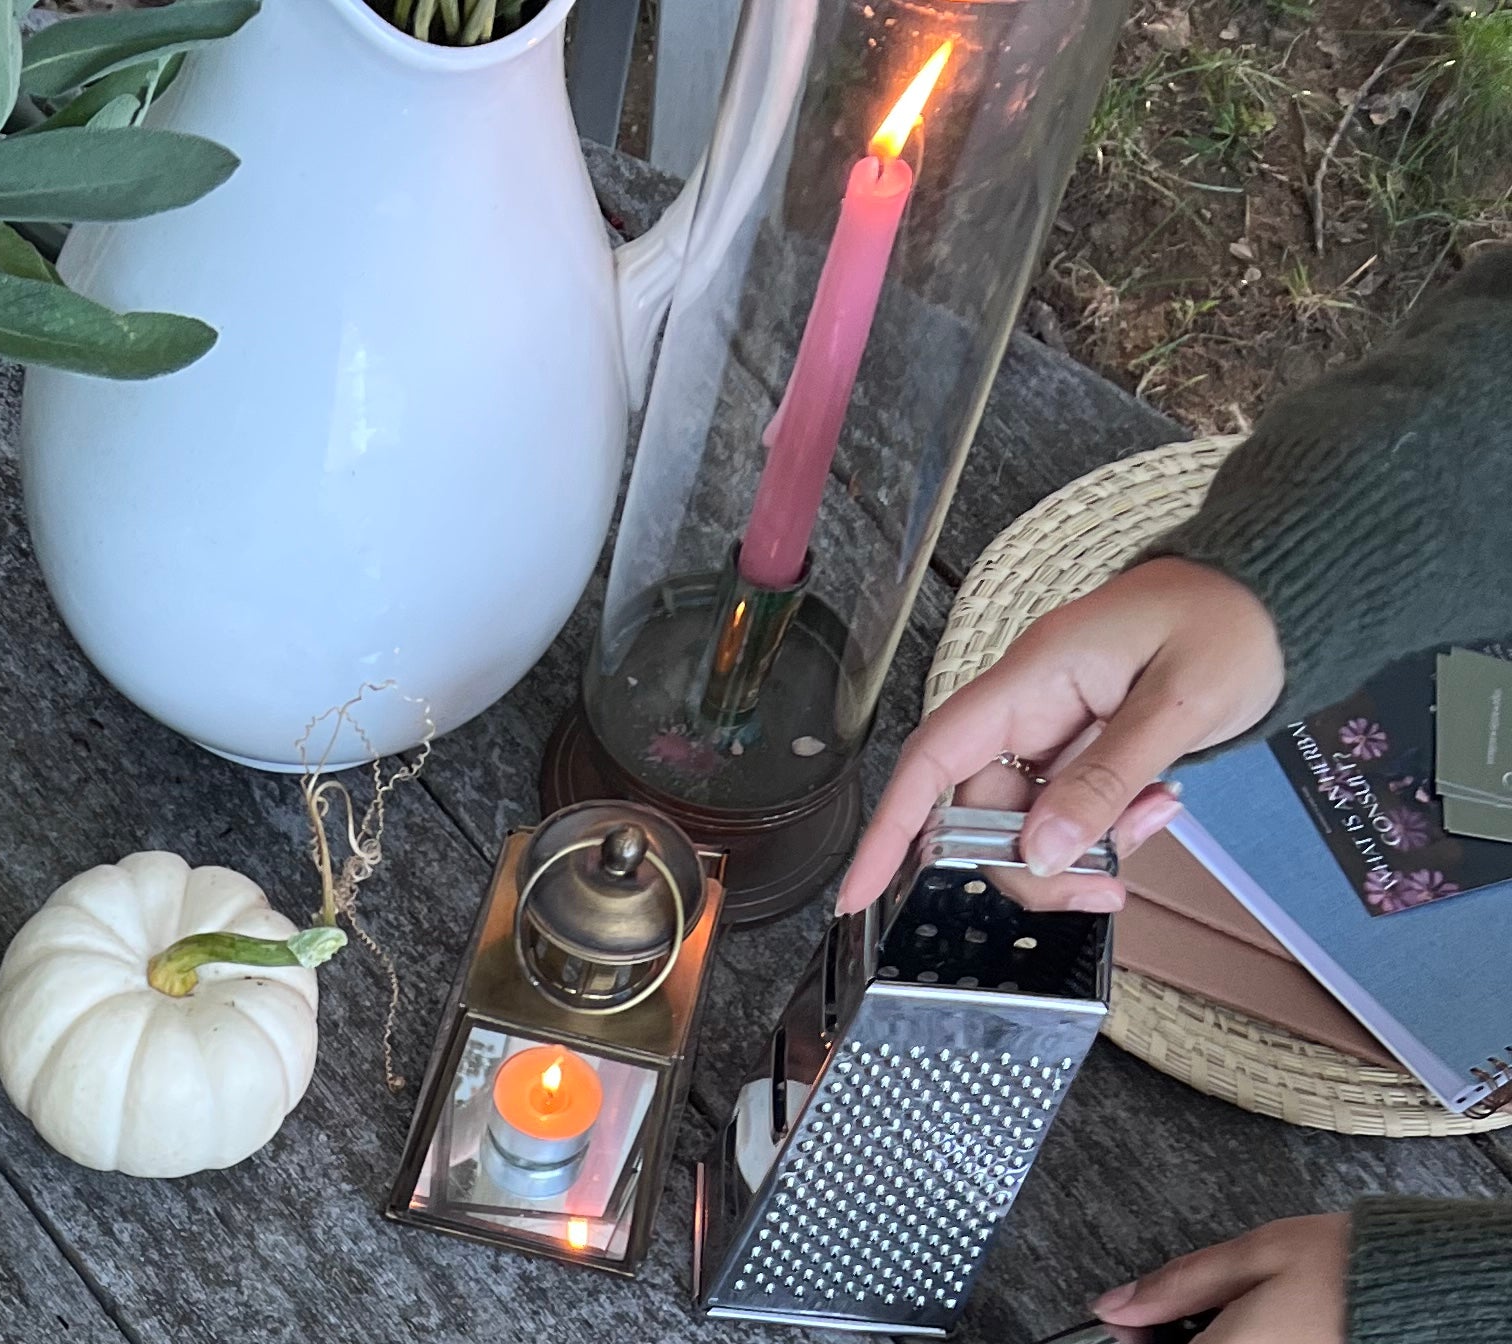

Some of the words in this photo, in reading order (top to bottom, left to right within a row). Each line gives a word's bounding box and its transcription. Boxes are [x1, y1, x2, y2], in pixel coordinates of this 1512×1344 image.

[1328, 784, 1354, 811] AN
[1343, 814, 1364, 832] IS
[1353, 837, 1399, 890] WHAT
